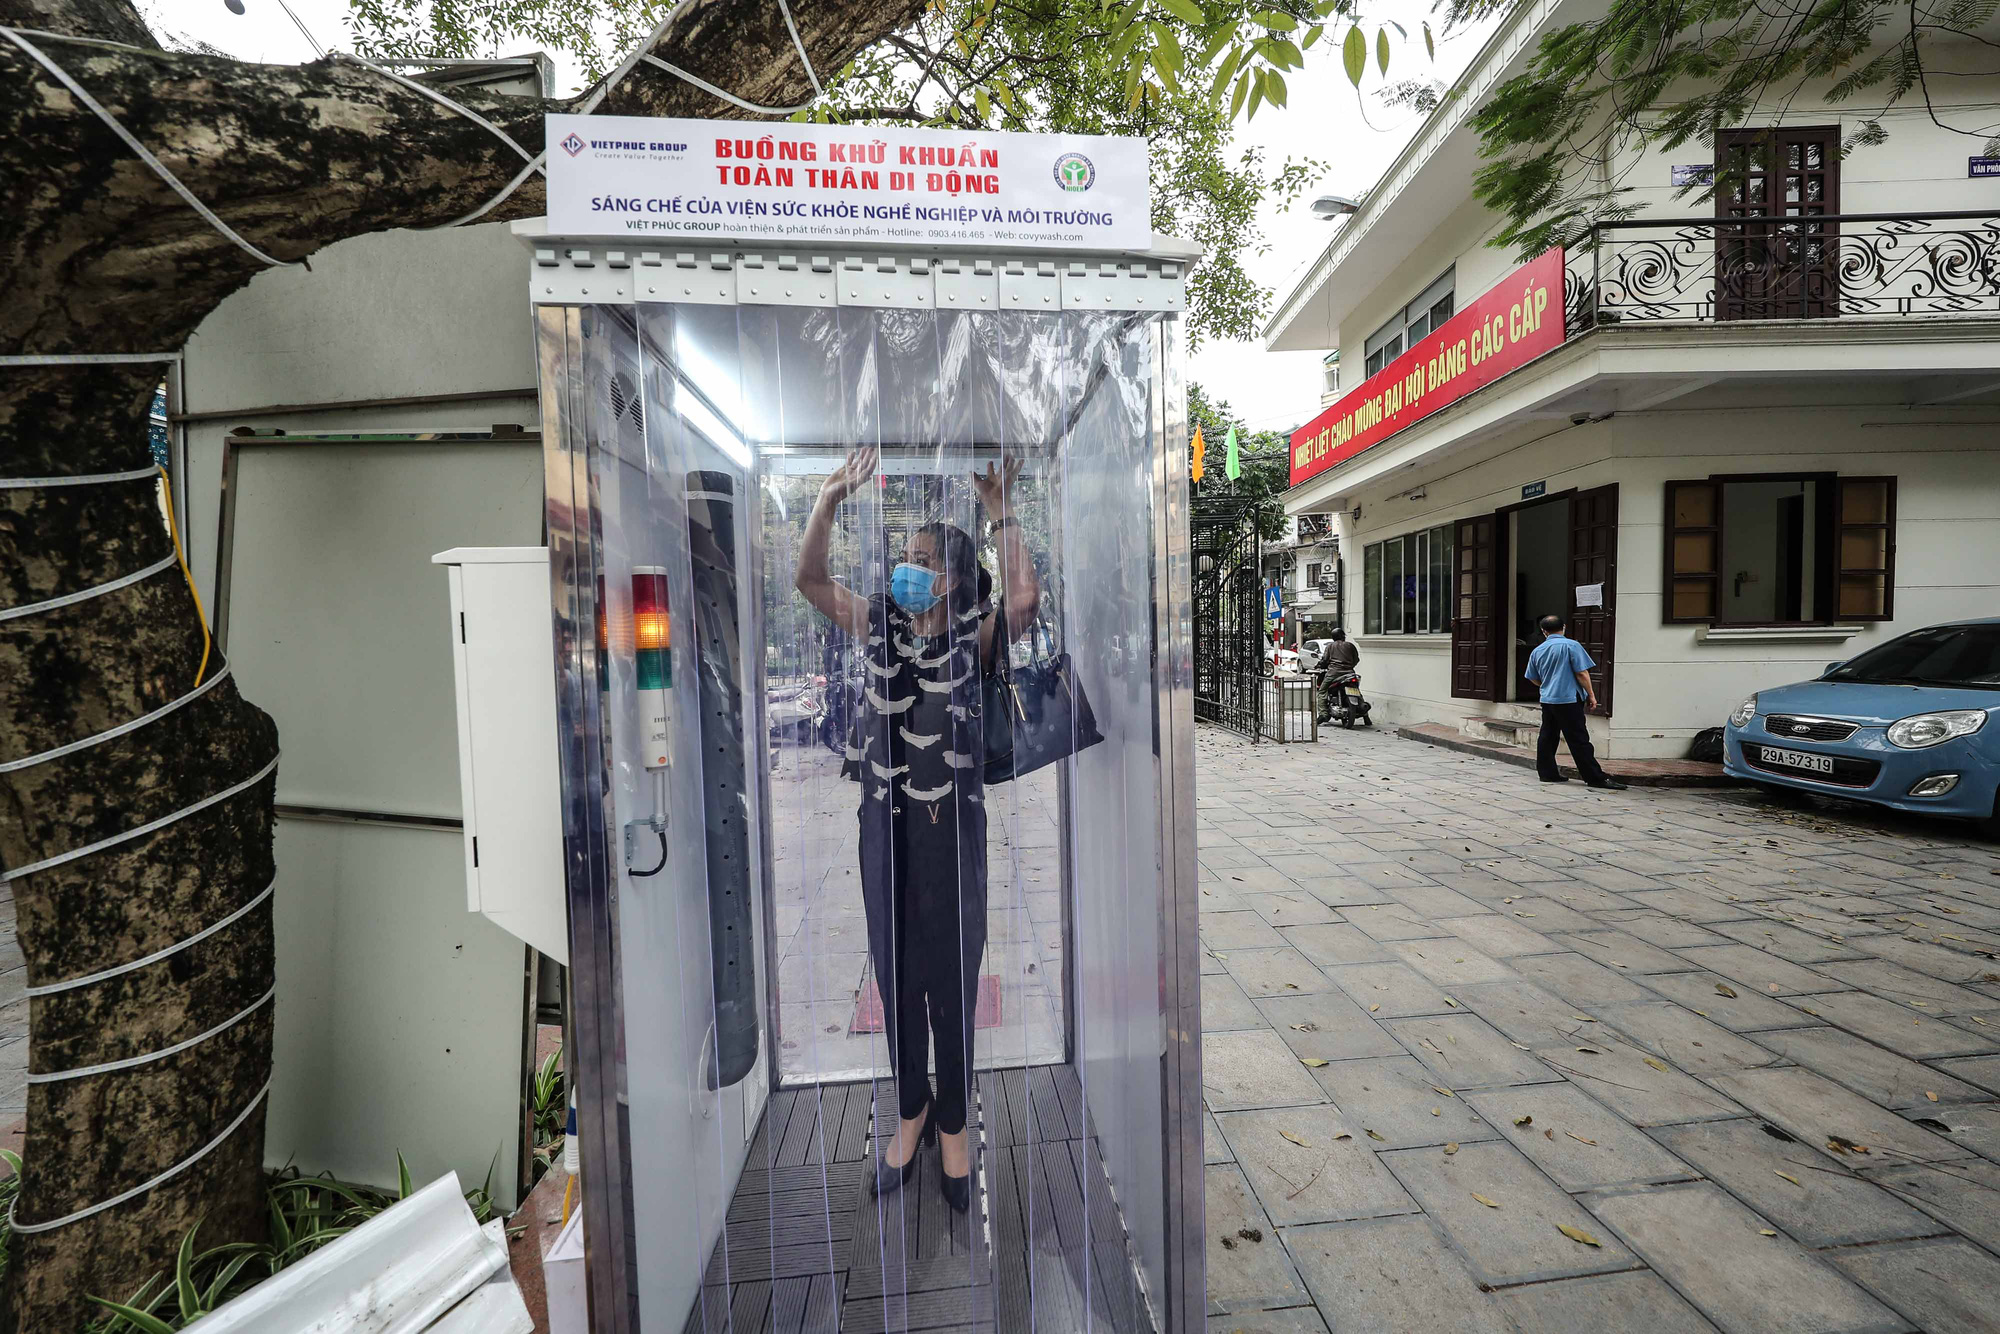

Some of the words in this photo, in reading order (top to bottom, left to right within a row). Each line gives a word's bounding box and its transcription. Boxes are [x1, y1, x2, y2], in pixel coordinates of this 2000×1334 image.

[590, 140, 646, 150] VIETPHUC
[650, 142, 687, 152] GROUP
[715, 134, 817, 162] BUỒNG
[829, 140, 887, 164] KHỬ
[898, 142, 998, 168] KHUẨN
[716, 163, 794, 188] TOÀN
[804, 166, 879, 190] THÂN
[890, 172, 914, 192] DI
[926, 170, 1000, 197] ĐỘNG
[592, 195, 642, 212] SÁNG
[646, 196, 682, 213] CHẾ
[686, 196, 722, 214] CỦA
[726, 199, 767, 219] VIỆN
[772, 200, 807, 217] SỨC
[812, 200, 859, 218] KHỎE
[864, 203, 911, 220] NGHỀ
[916, 206, 978, 226] NGHIỆP
[982, 206, 1004, 222] VÀ
[1008, 208, 1040, 224] MÔI
[1043, 209, 1113, 226] TRƯỜNG
[626, 219, 650, 231] VIỆT
[652, 220, 681, 230] PHÚC
[684, 222, 721, 231] GROUP
[723, 222, 748, 232] hoàn
[750, 224, 775, 234] thiện
[776, 225, 784, 233] &
[786, 225, 808, 235] phát
[810, 225, 832, 234] triển
[834, 226, 850, 235] sản
[852, 226, 880, 237] phẩm
[887, 228, 924, 238] Hotline:
[928, 230, 985, 239] 0903.416.465
[994, 231, 1017, 240] Web:
[1018, 232, 1084, 242] covywash.com
[1294, 436, 1314, 470] NHIỆT
[1314, 426, 1330, 460] LIỆT
[1331, 413, 1353, 450] CHÀO
[1354, 394, 1382, 436] MỪNG
[1384, 380, 1403, 420] ĐẠI
[1405, 362, 1426, 408] HỘI
[1428, 341, 1467, 393] ĐẢNG
[1470, 314, 1504, 367] CÁC
[1509, 278, 1548, 344] CẤP
